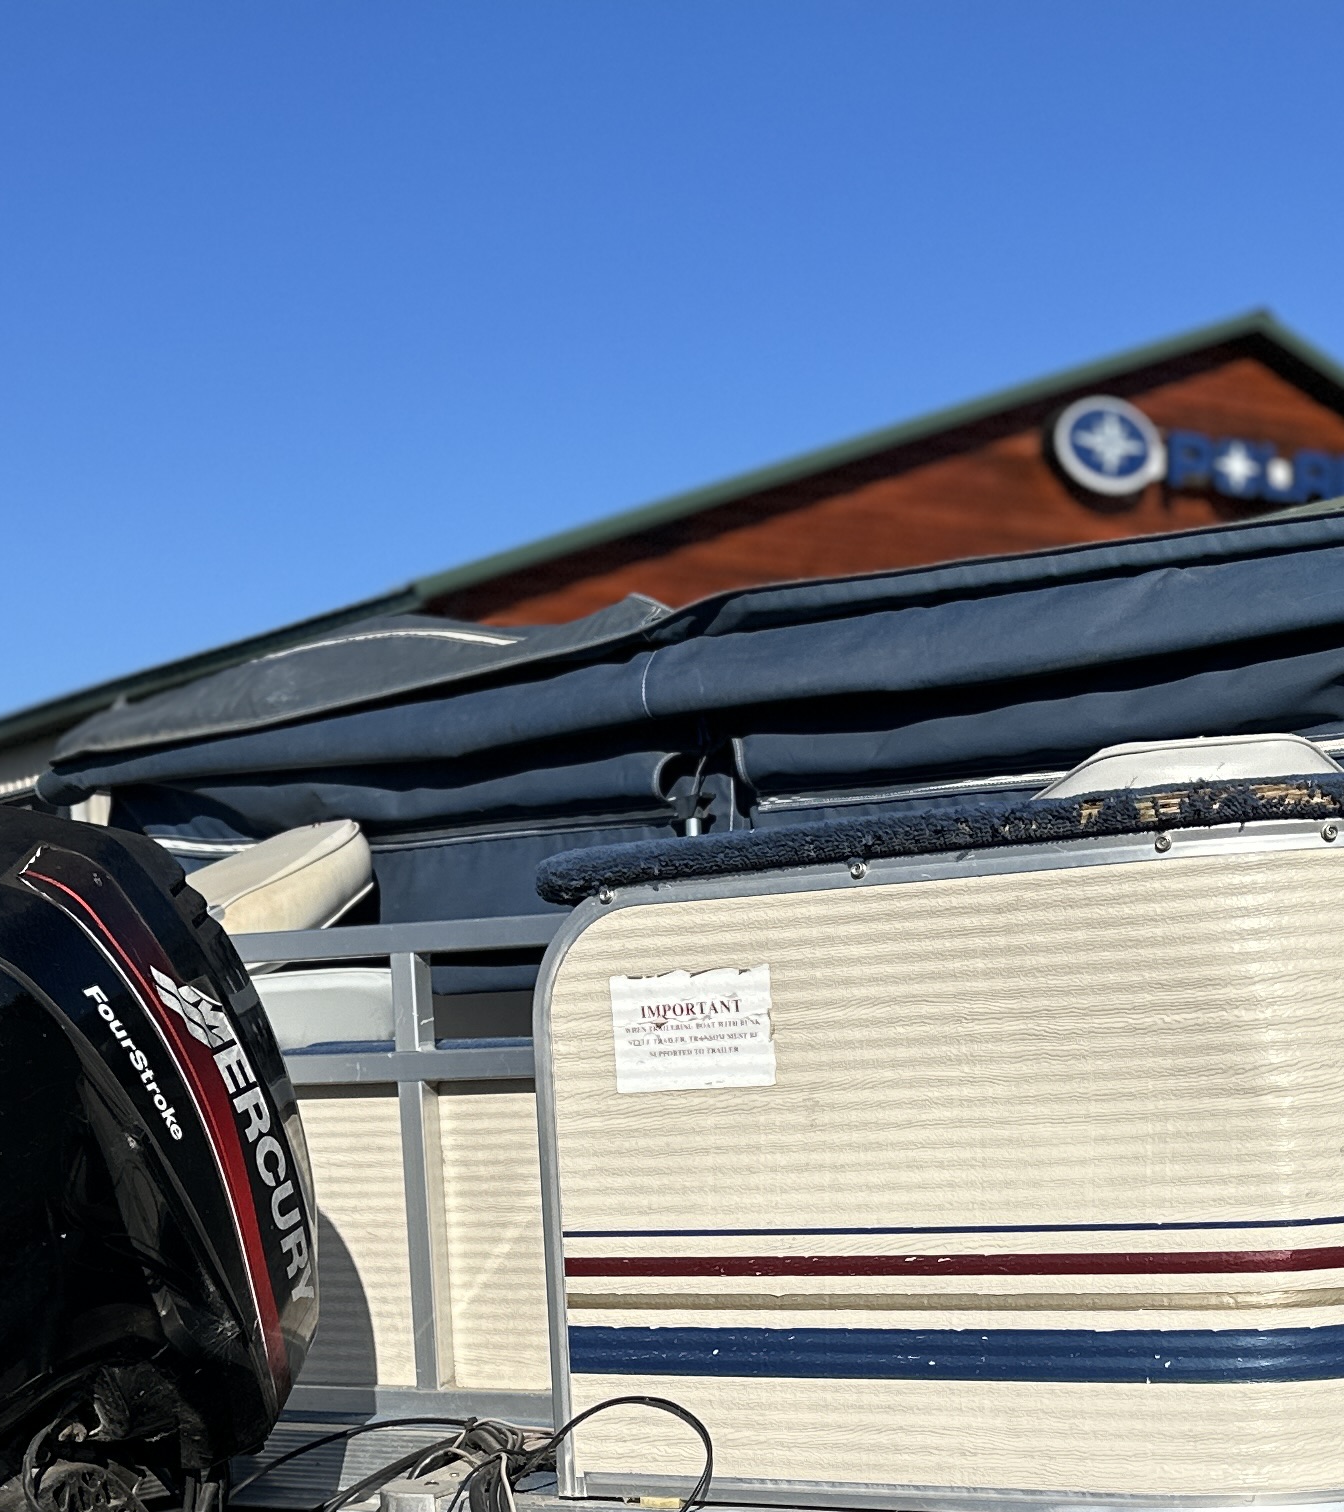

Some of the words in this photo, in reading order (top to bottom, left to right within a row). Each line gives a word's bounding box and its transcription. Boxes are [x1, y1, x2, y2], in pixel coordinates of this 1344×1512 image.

[82, 985, 183, 1142] FourStroke
[641, 999, 742, 1018] IMPORTANT
[161, 973, 314, 1302] MERCURY
